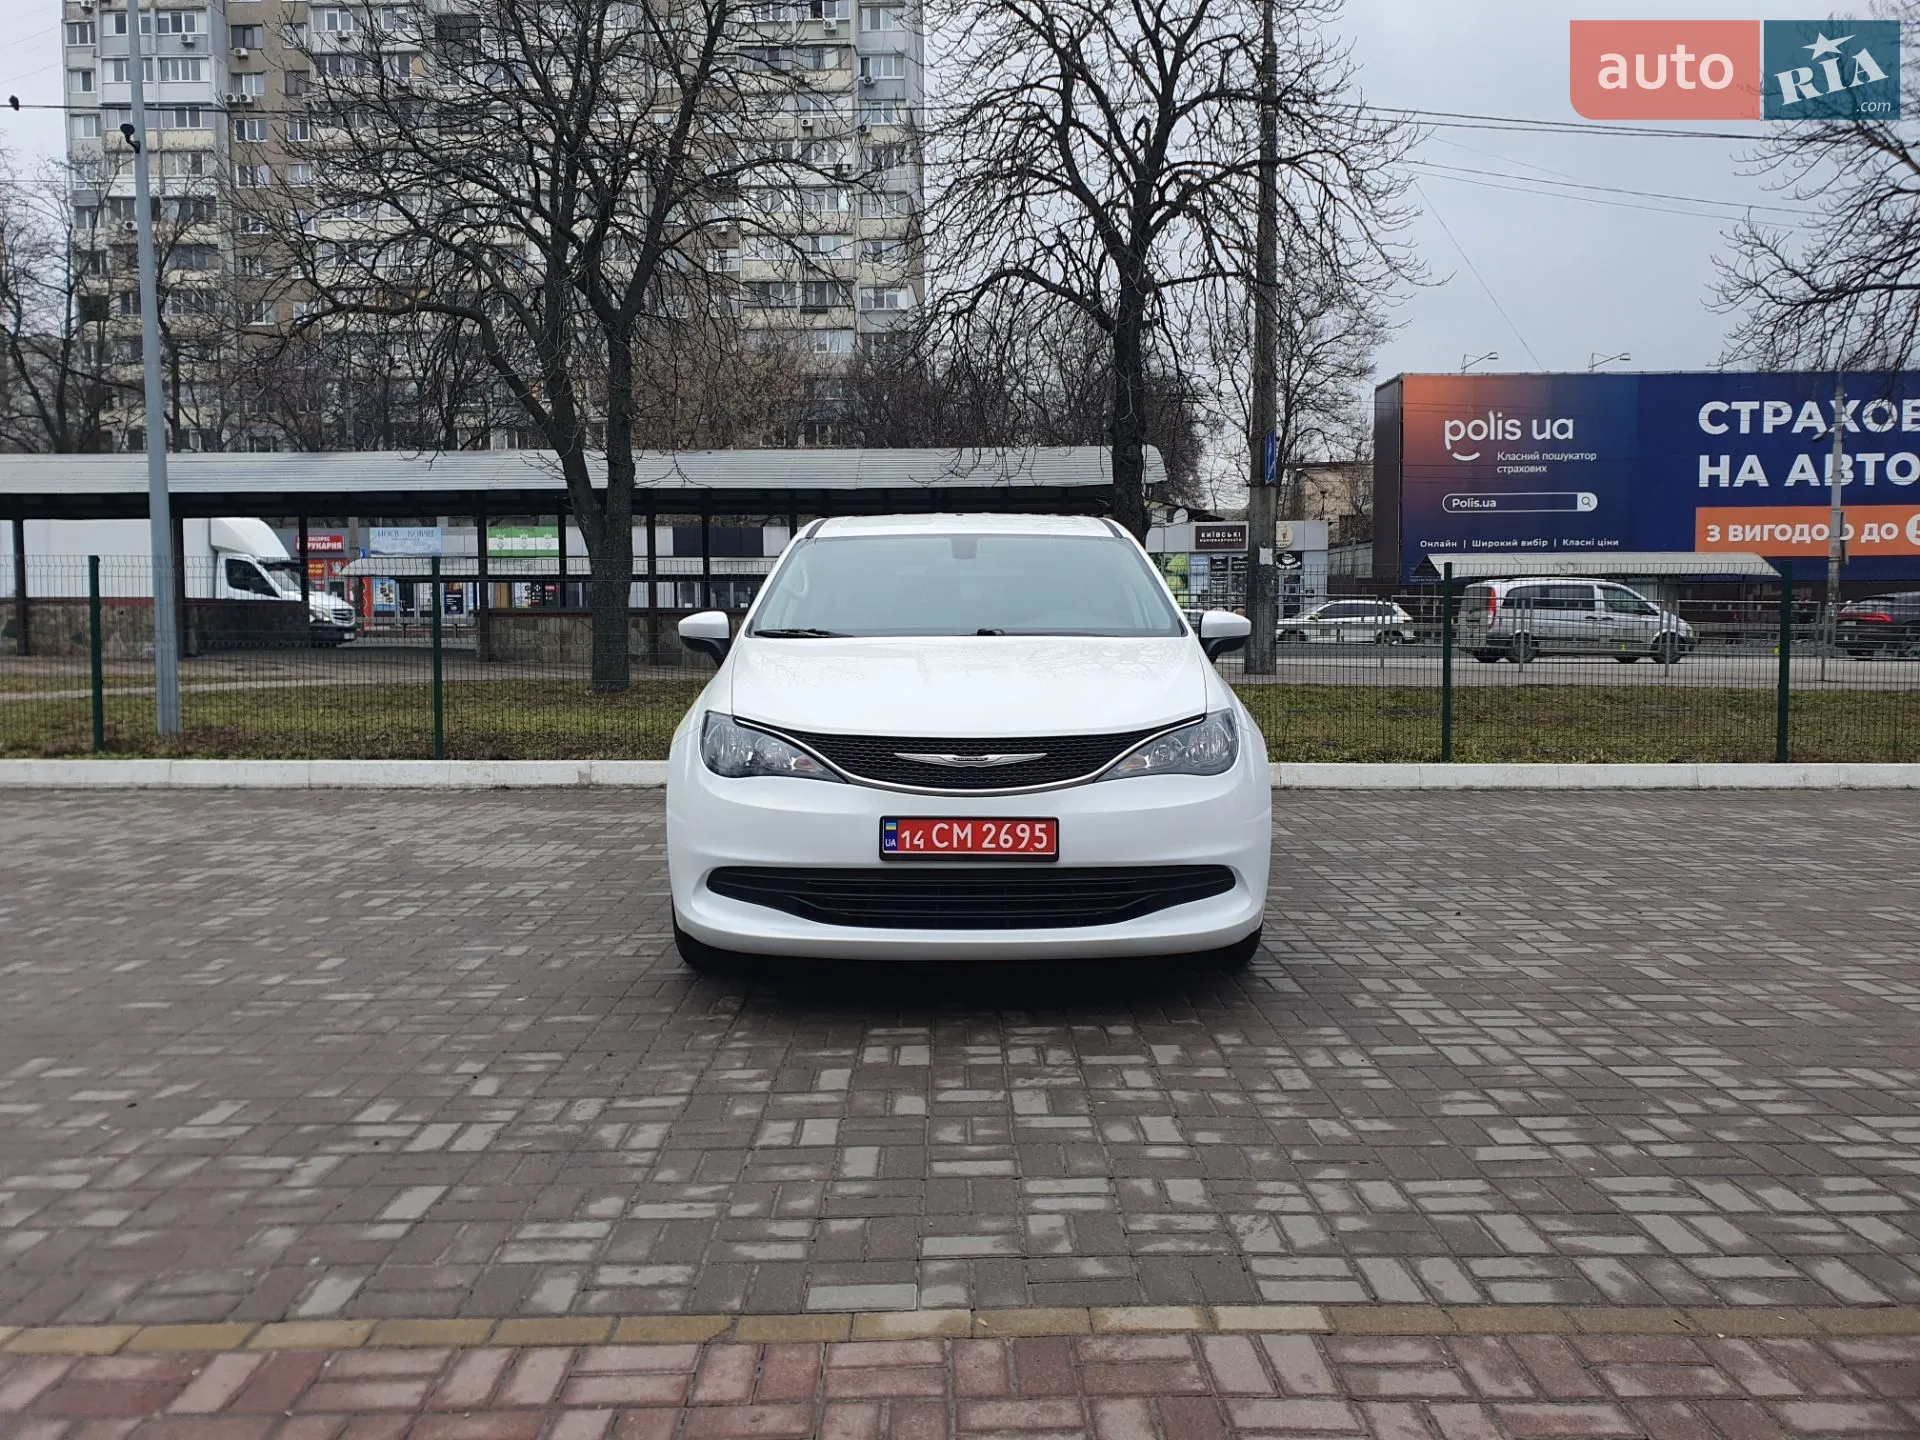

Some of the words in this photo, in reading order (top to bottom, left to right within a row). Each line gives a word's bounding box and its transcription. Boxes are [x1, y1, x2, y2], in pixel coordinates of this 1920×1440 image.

[1445, 411, 1522, 450] polis
[1532, 419, 1574, 440] ua
[1497, 451, 1540, 461] Класний
[1542, 453, 1597, 462] пошукатор
[1497, 465, 1547, 474] страхових
[1698, 454, 1769, 487] НА
[1784, 452, 1920, 487] АВТО
[1452, 498, 1497, 508] Polis.ua
[1860, 522, 1899, 543] ДО
[1420, 539, 1457, 548] Онлайн
[1472, 538, 1518, 547] Широкий
[1521, 538, 1548, 547] вибір
[1562, 538, 1595, 546] Класні
[885, 838, 897, 847] UA
[901, 830, 924, 849] 14
[932, 823, 972, 848] CM
[982, 823, 1048, 849] 2695
